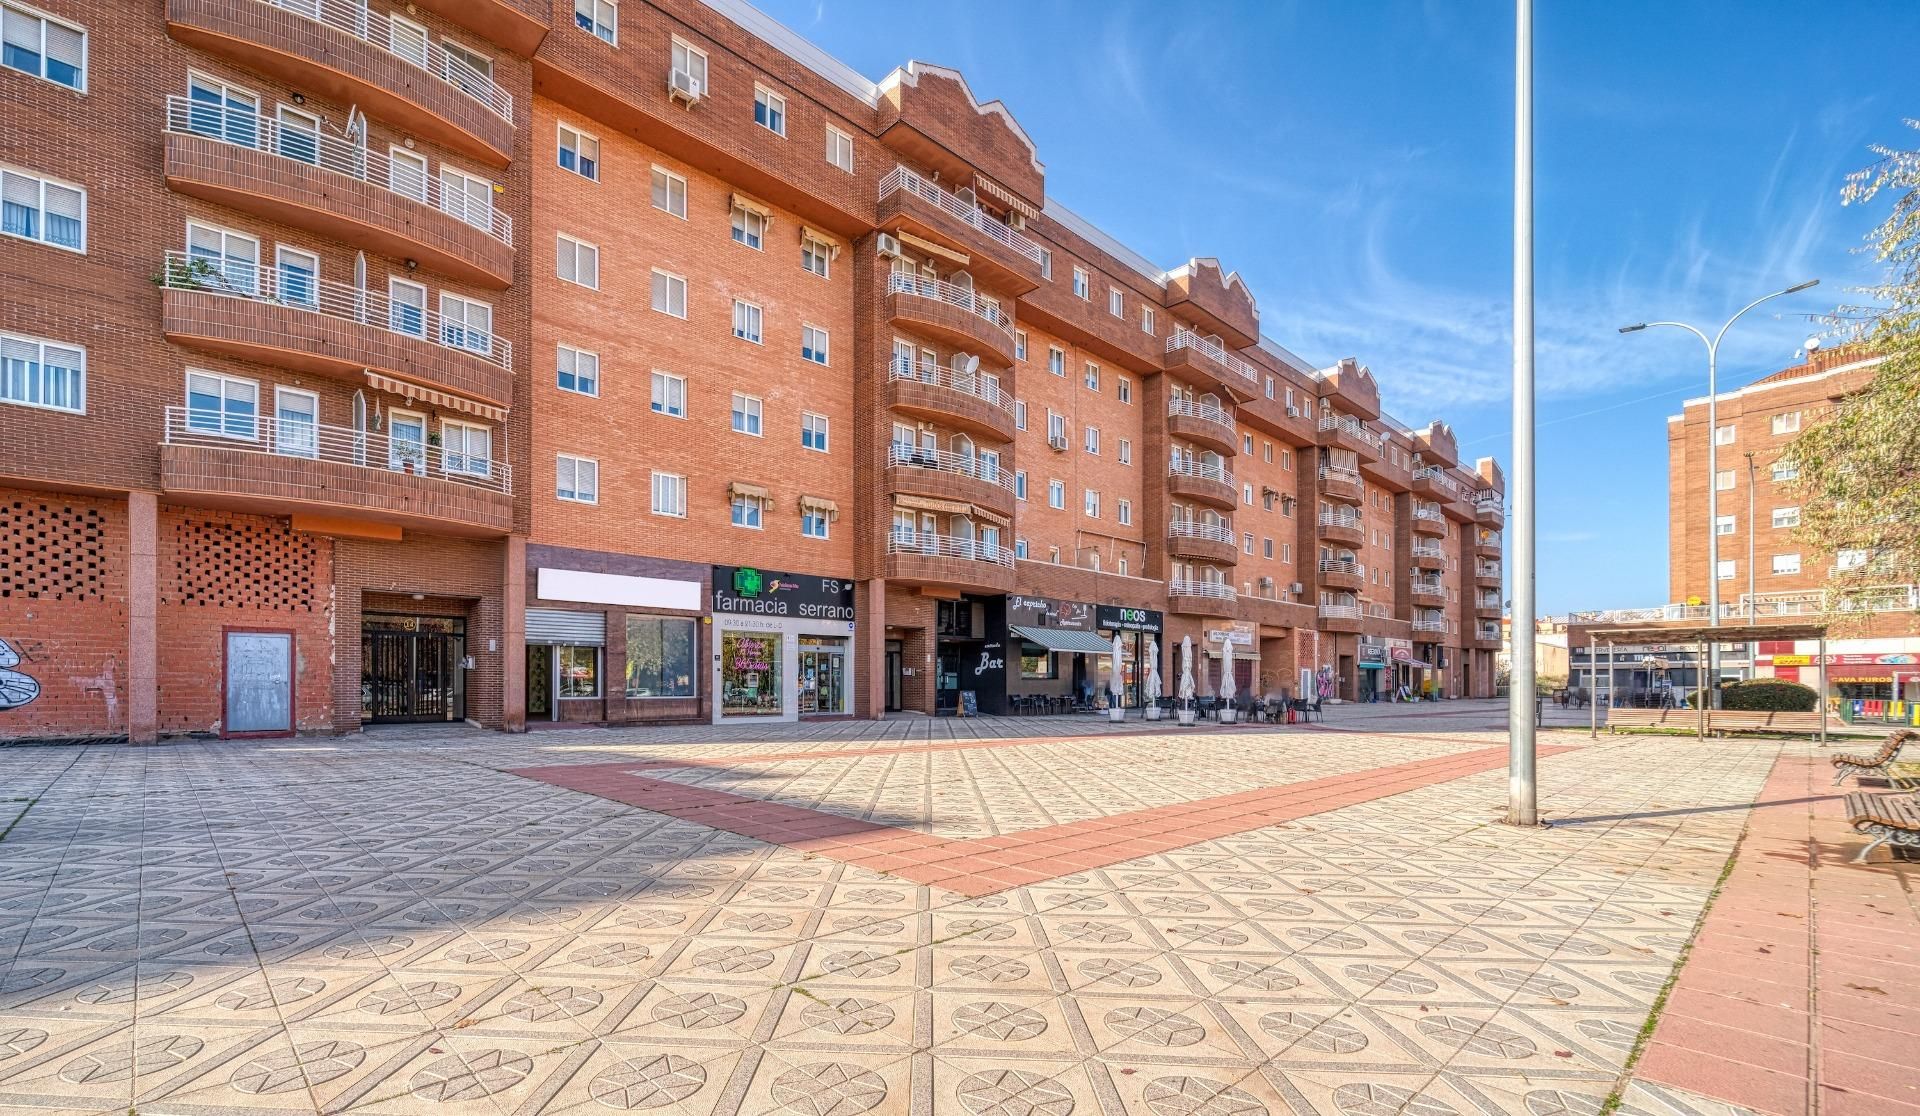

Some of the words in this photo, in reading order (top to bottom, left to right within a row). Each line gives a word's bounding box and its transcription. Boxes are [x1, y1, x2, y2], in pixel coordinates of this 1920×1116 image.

[822, 579, 839, 594] FS
[715, 590, 788, 614] farmacia
[799, 603, 854, 619] serrano
[1120, 608, 1146, 622] neos
[974, 651, 1004, 676] Bar
